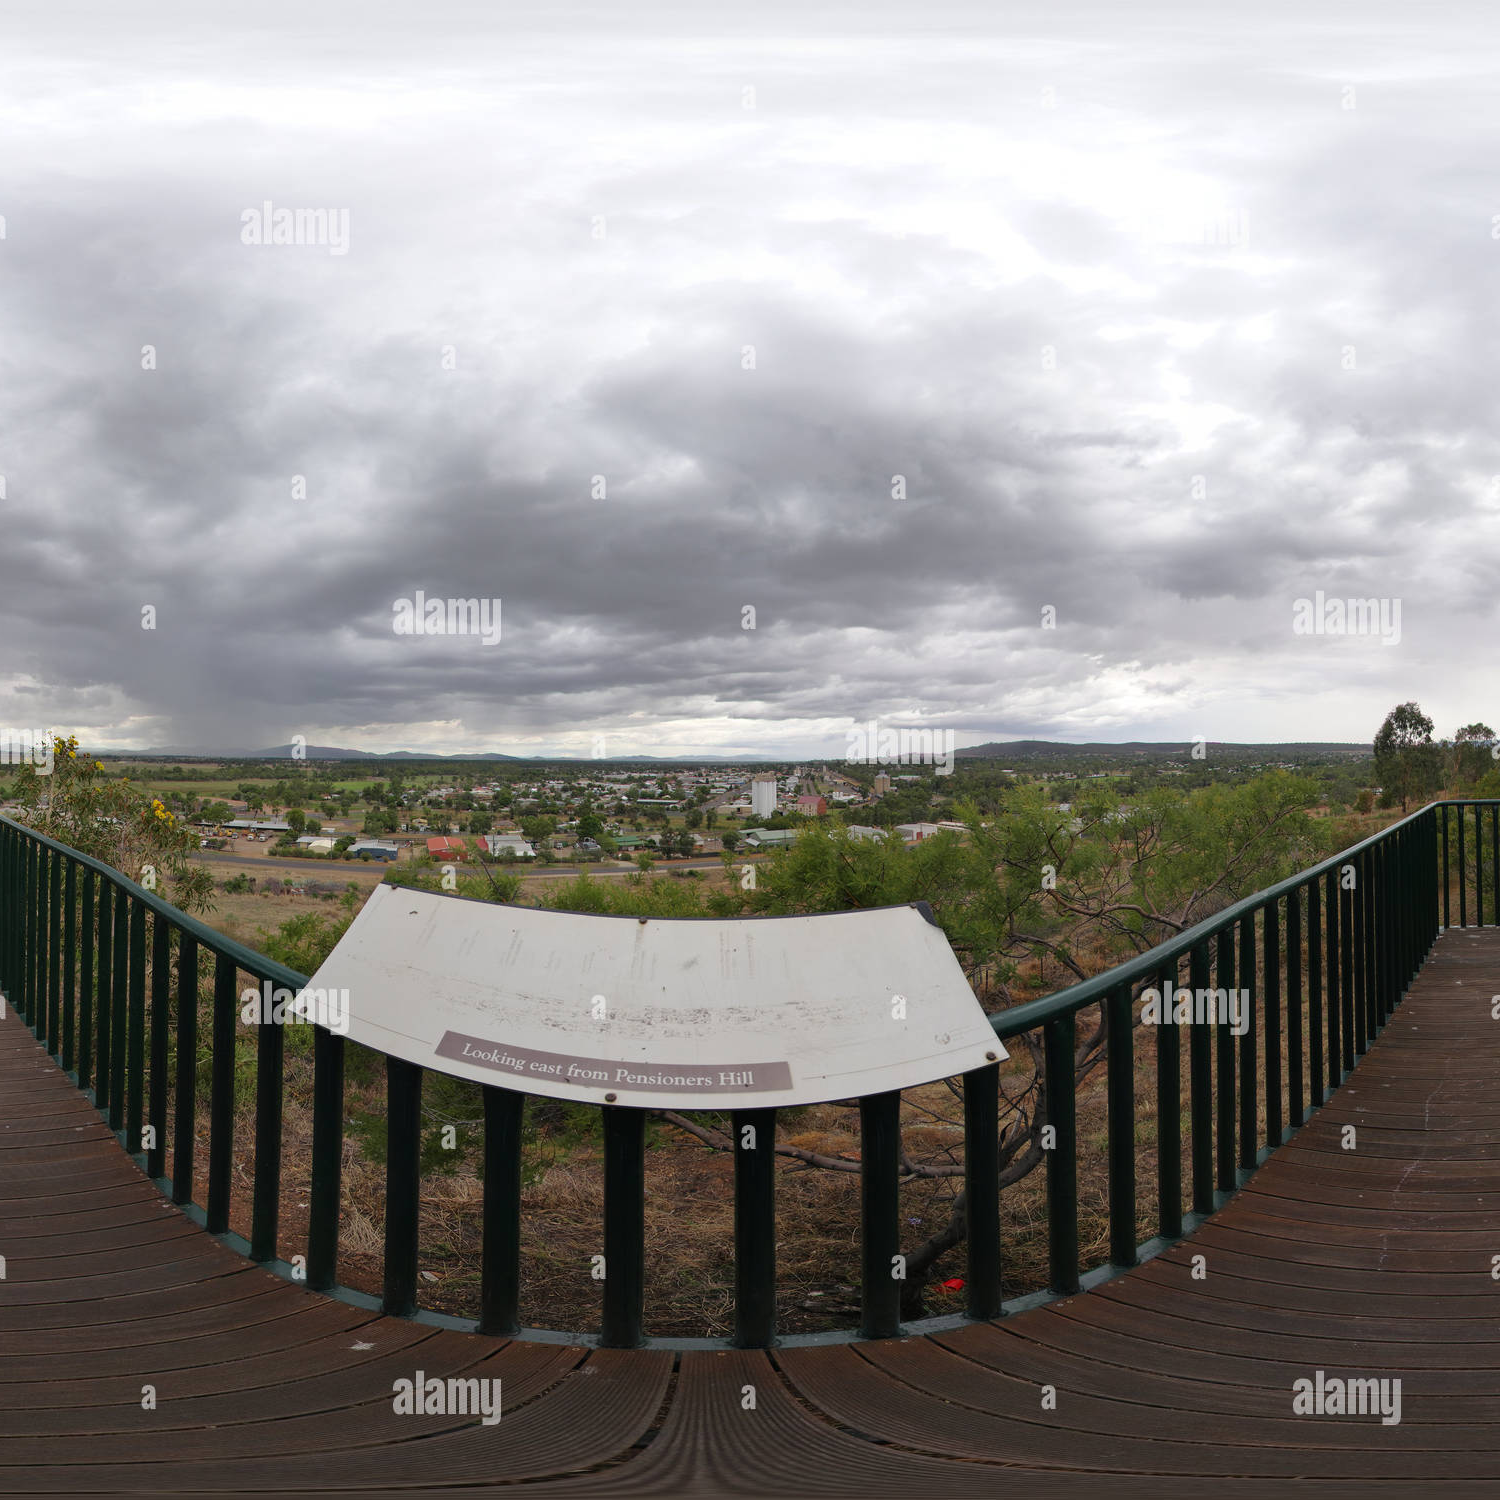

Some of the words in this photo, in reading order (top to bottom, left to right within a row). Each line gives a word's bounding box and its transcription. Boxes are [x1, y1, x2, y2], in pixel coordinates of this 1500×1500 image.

[462, 1042, 526, 1071] Looking
[530, 1061, 562, 1075] east
[567, 1063, 608, 1081] from
[615, 1068, 712, 1087] Pensioners
[718, 1071, 755, 1086] Hill
